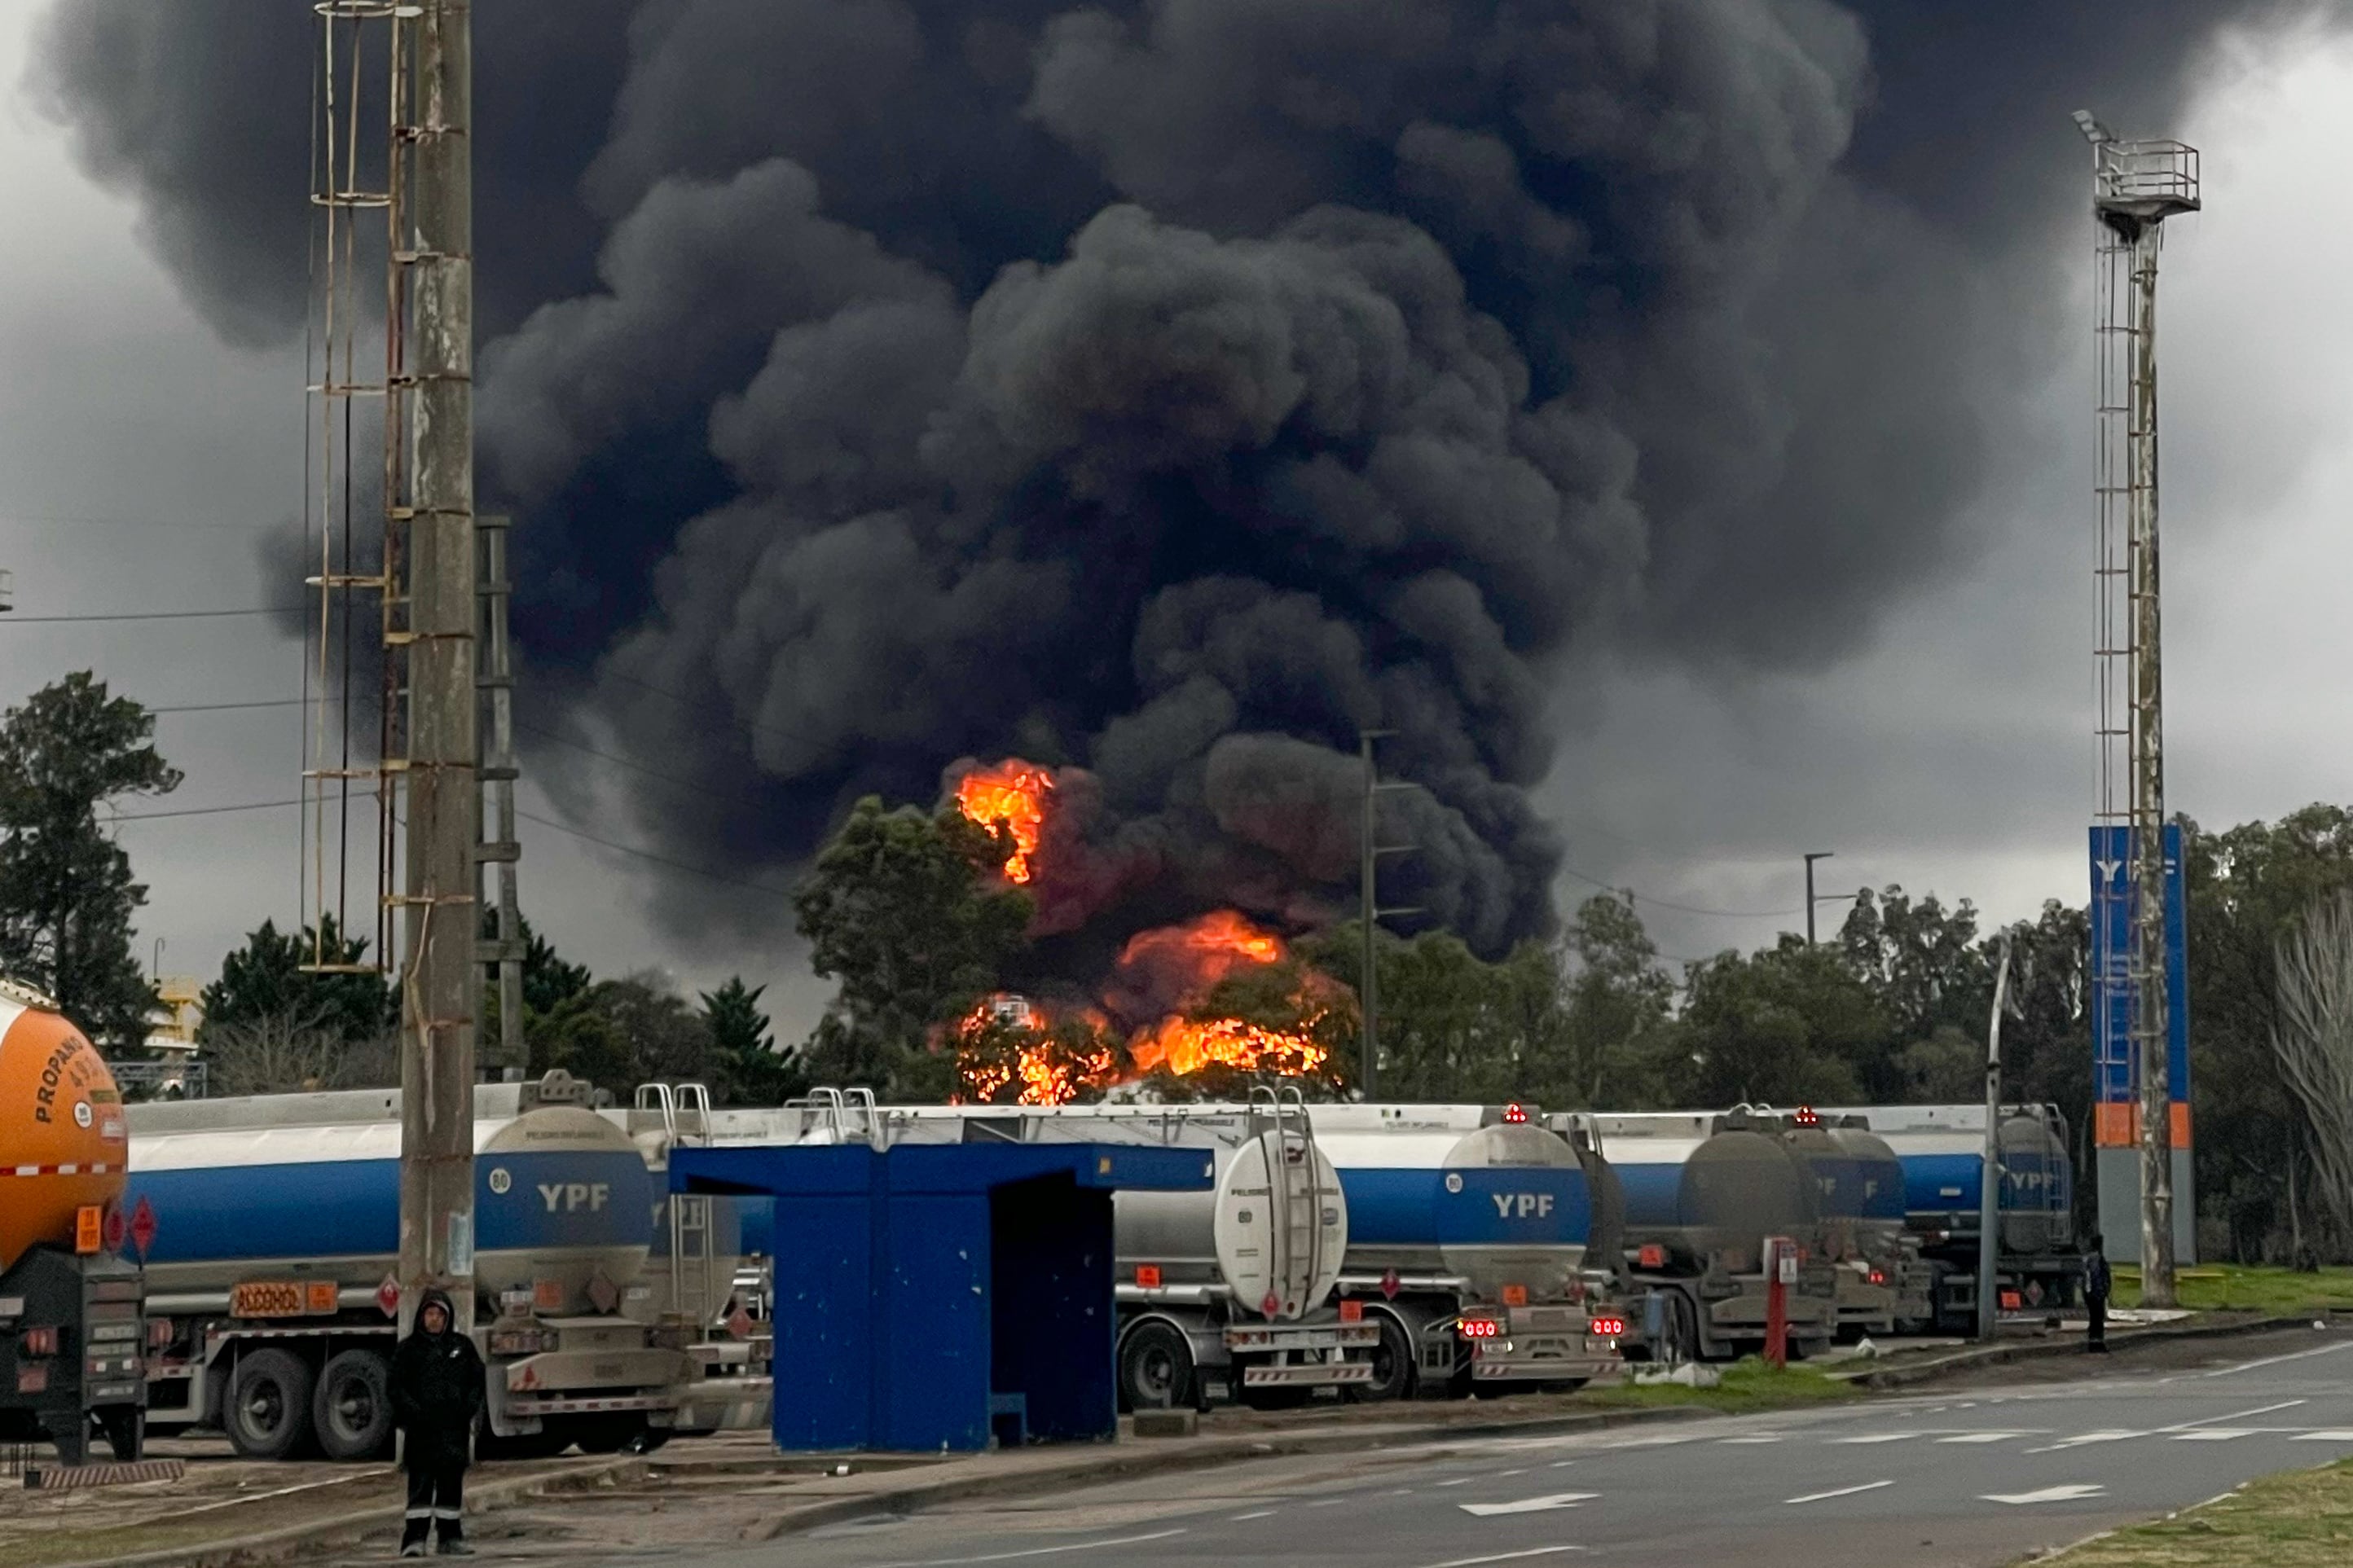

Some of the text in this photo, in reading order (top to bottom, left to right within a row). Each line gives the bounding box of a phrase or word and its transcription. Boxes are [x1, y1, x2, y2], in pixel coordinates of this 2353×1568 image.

[492, 1174, 508, 1188] 80
[537, 1184, 609, 1212] YPF
[1493, 1194, 1554, 1217] YPF
[235, 1288, 299, 1311] ALCOHOL
